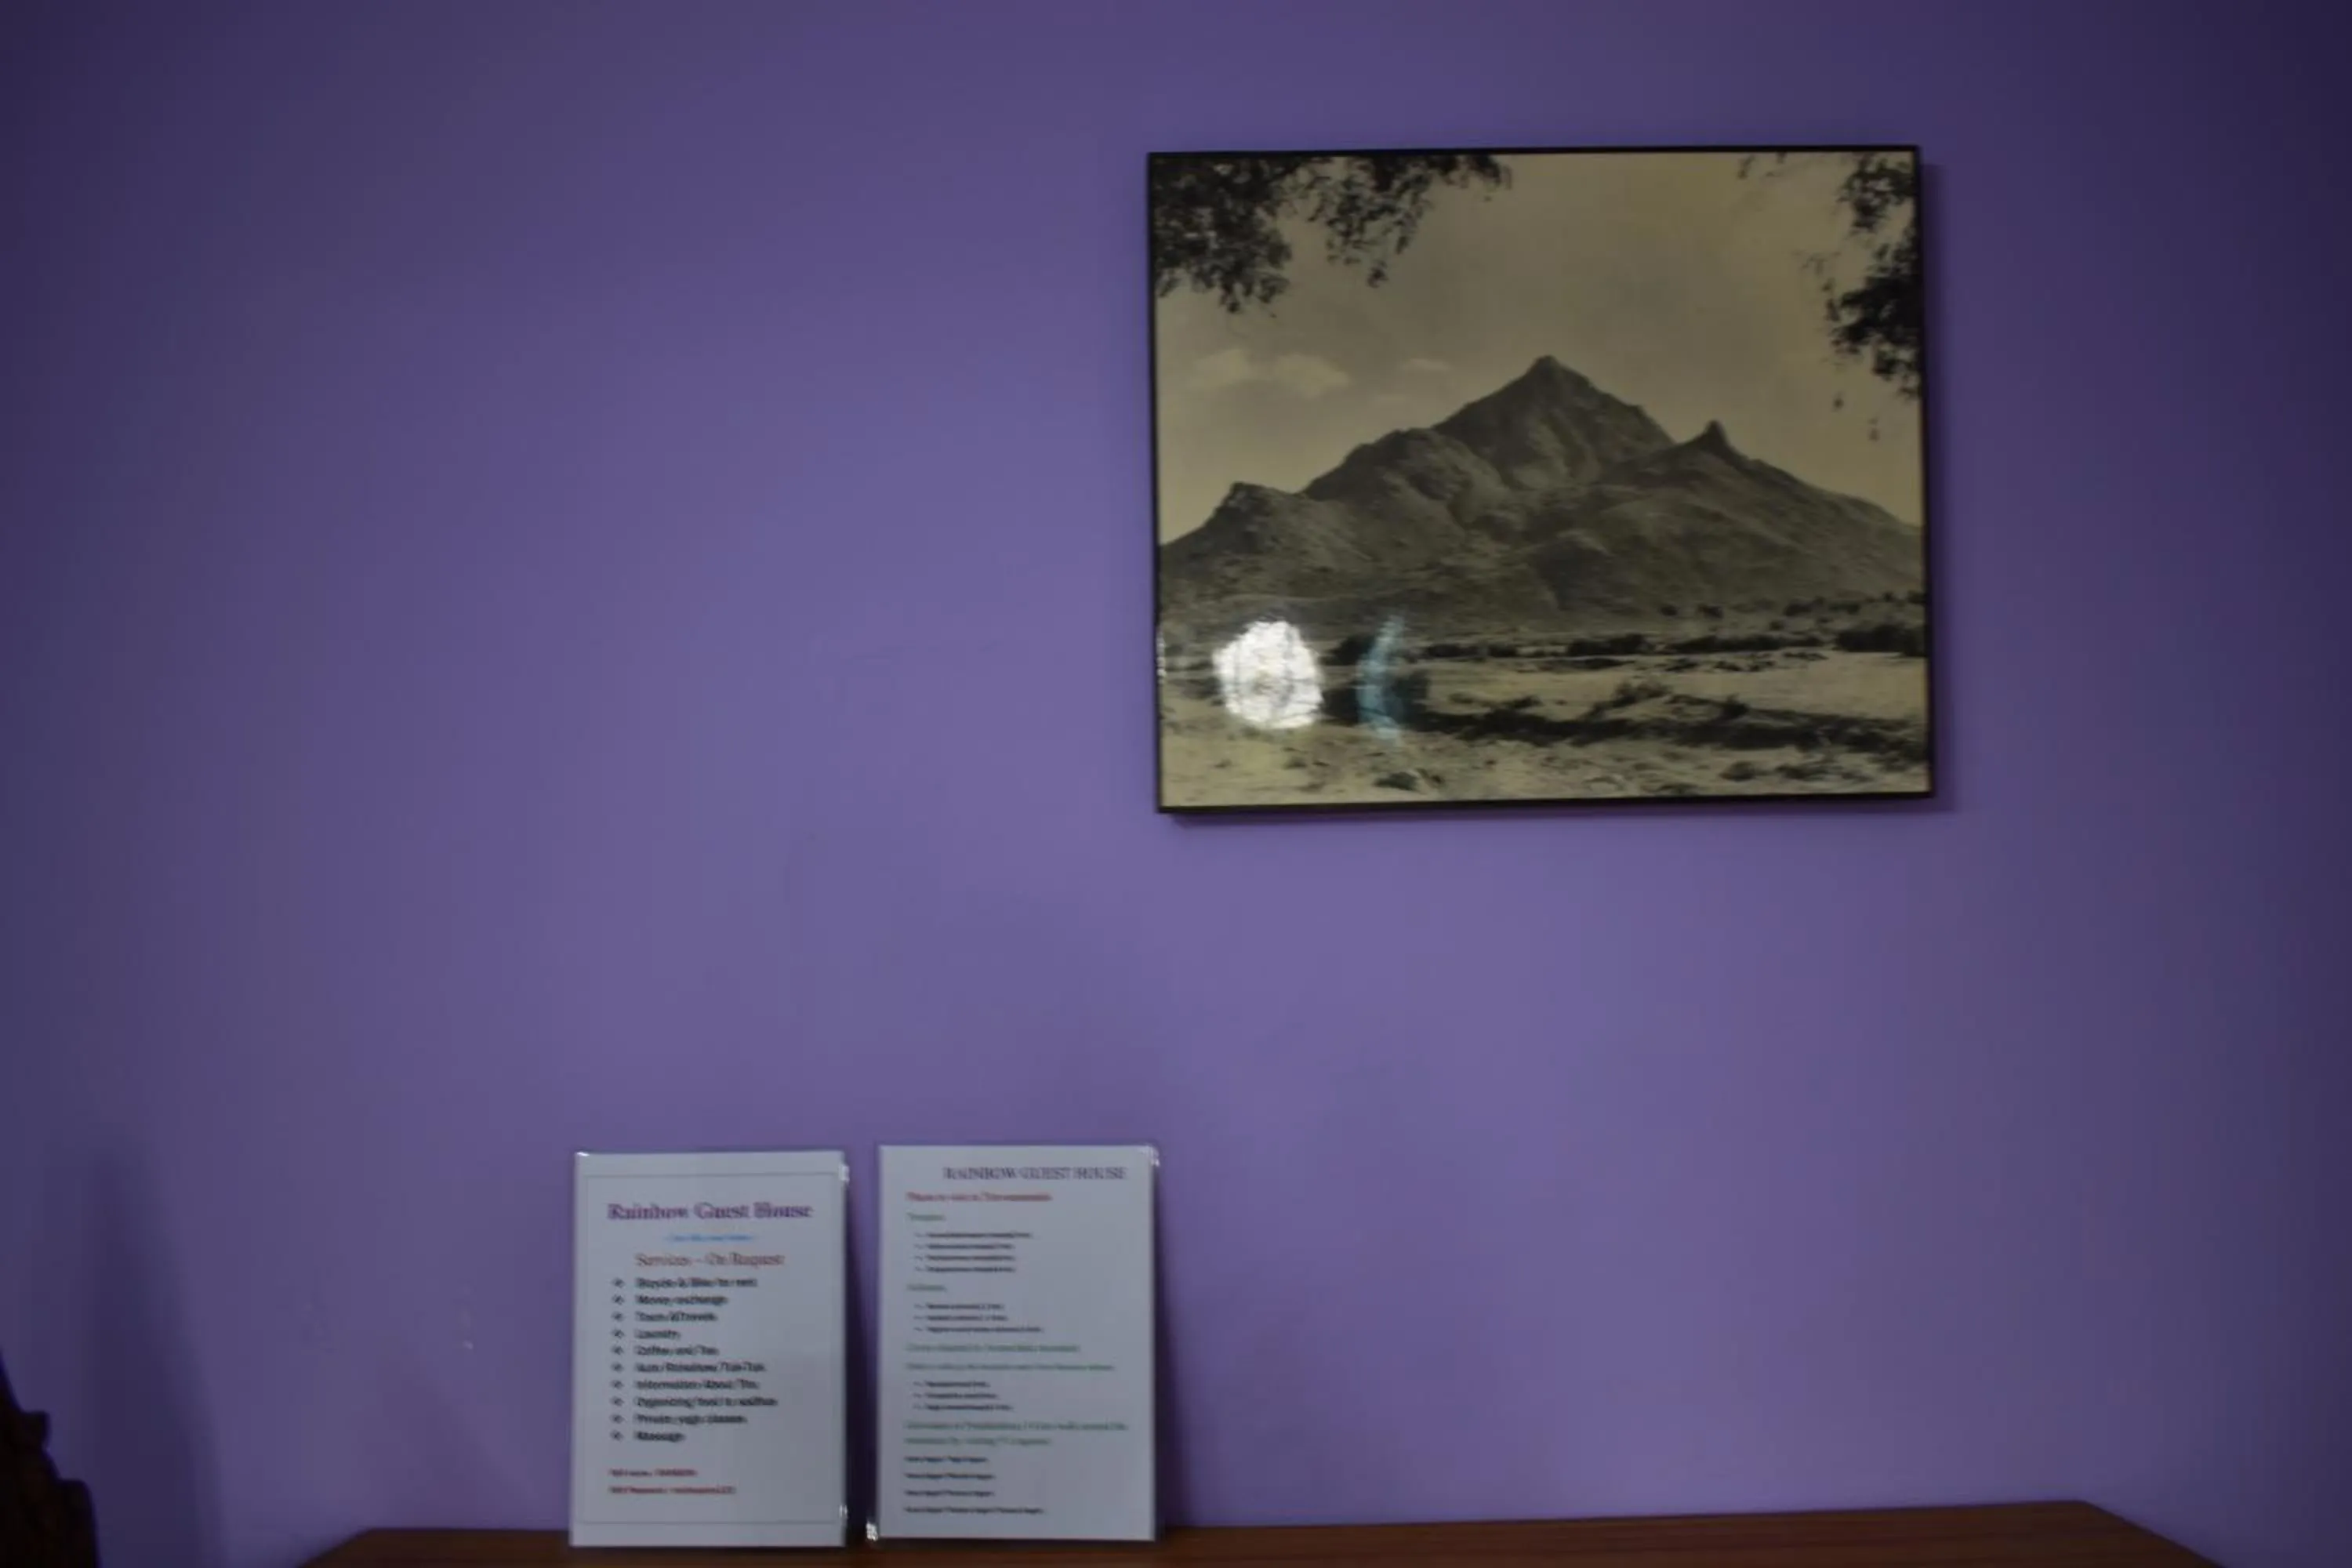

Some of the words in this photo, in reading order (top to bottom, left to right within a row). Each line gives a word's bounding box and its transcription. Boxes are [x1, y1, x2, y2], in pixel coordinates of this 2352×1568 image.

[605, 1203, 688, 1221] Rainbow
[694, 1203, 750, 1219] Guest
[753, 1201, 815, 1218] House
[635, 1254, 691, 1267] Services
[730, 1252, 785, 1269] Request
[635, 1294, 673, 1305] Money
